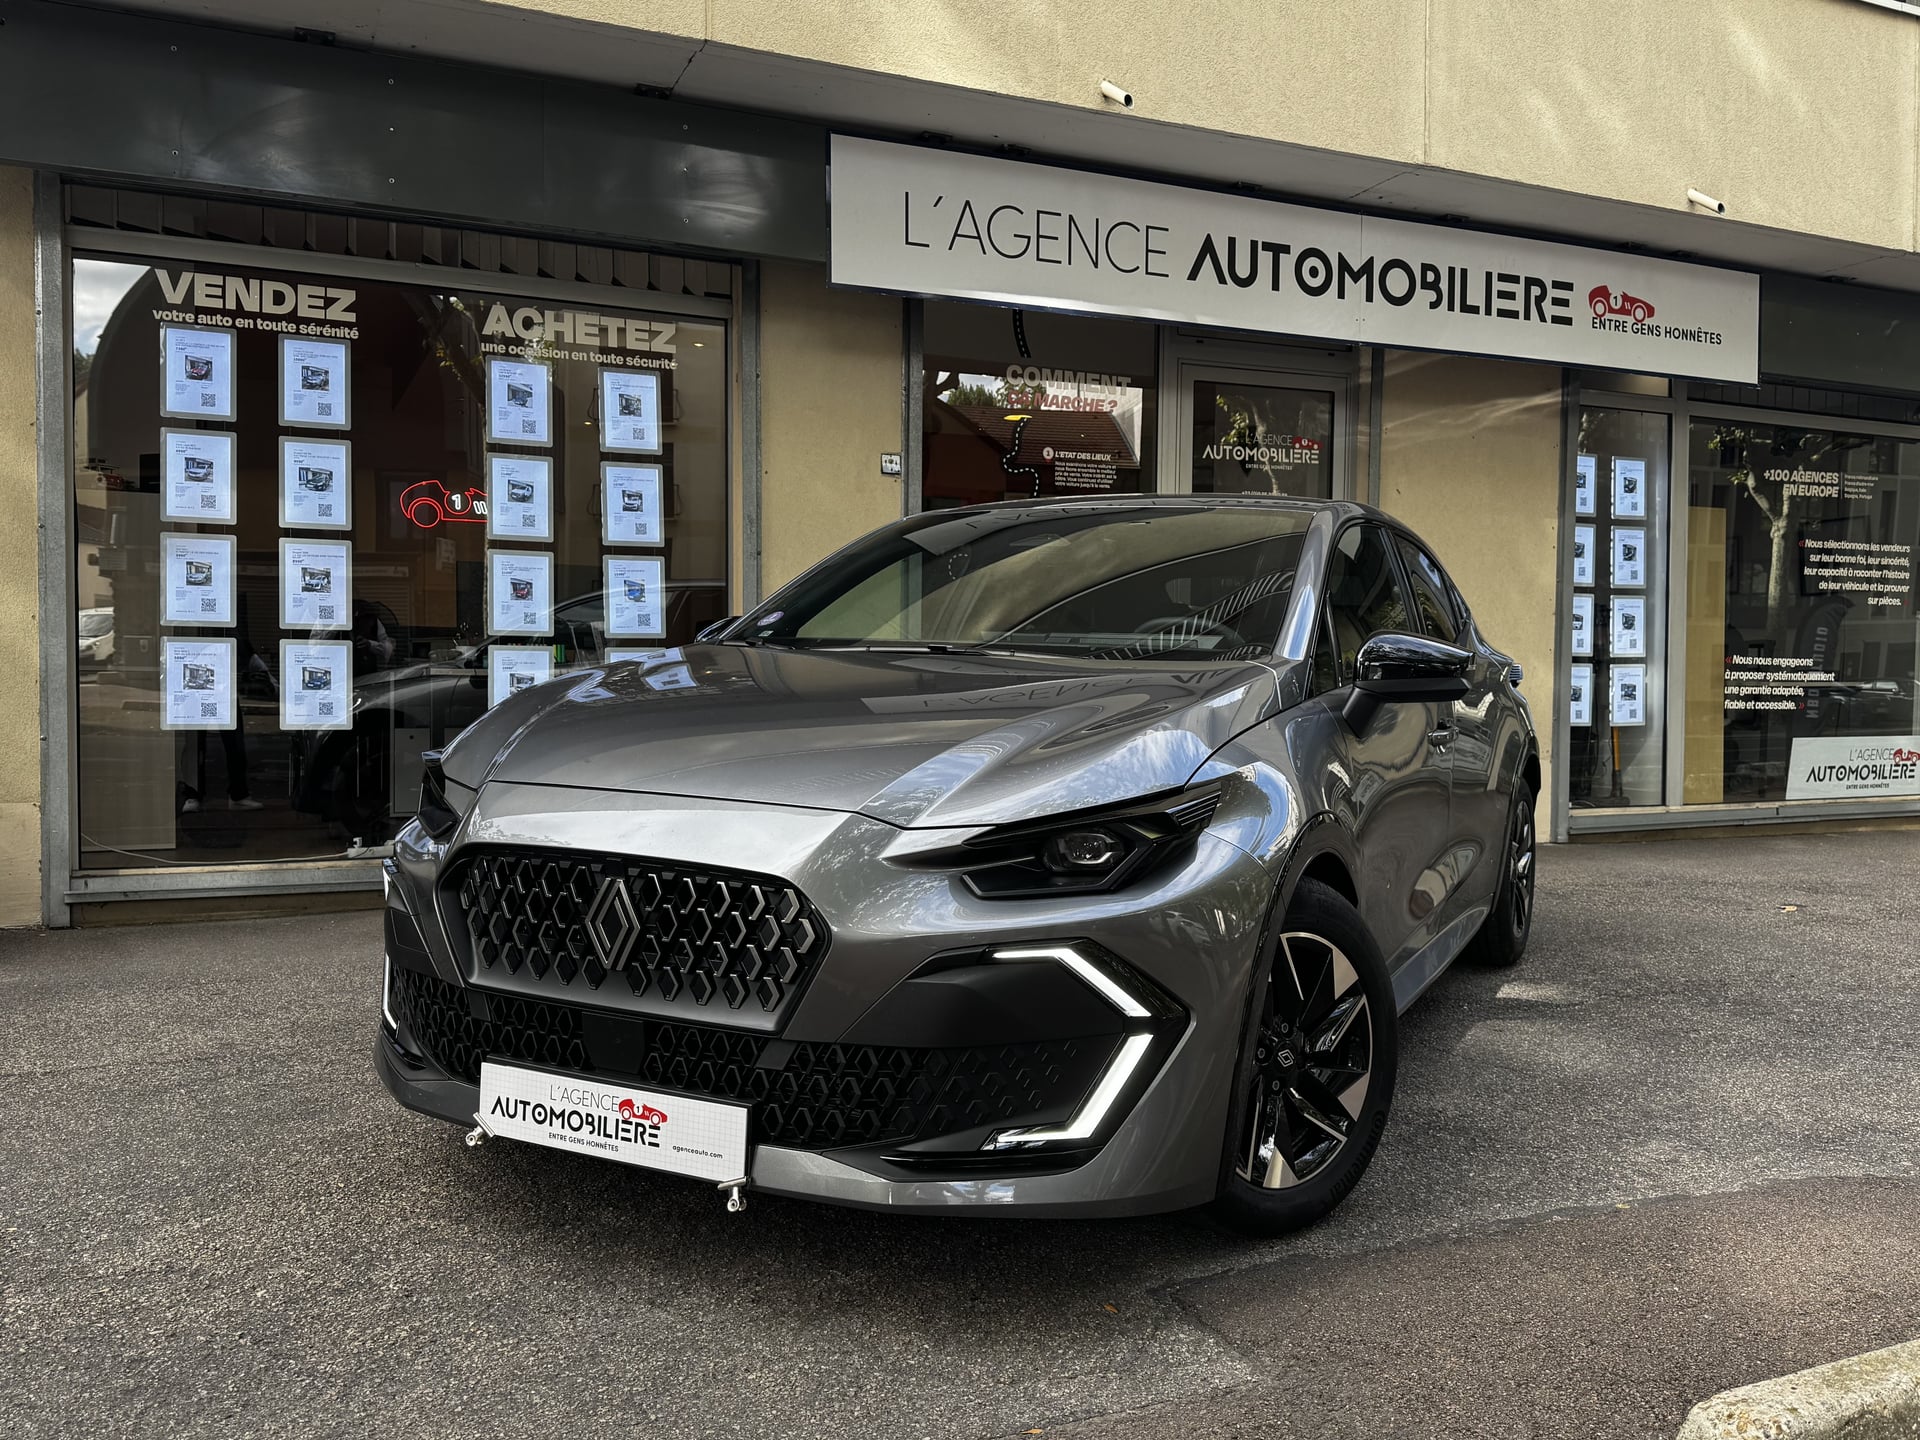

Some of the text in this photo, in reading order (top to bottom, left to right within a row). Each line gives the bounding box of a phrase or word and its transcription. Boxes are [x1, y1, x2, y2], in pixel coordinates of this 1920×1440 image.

[904, 190, 1574, 327] L'AGENCE AUTOMOBILIERE
[154, 268, 356, 322] VENDEZ
[152, 309, 359, 339] votre auto en toute sérénité
[481, 304, 676, 353] ACHETEZ
[1591, 316, 1722, 345] ENTRE GENS HONNÊTES
[480, 341, 679, 370] une occasion en toute sécurité
[1006, 364, 1131, 396] COMMENT
[1033, 392, 1105, 412] MARCHE
[1077, 452, 1090, 460] DES
[1091, 453, 1111, 461] LIEUX
[1202, 444, 1319, 464] AUTOMOBILIERE
[1763, 469, 1790, 481] +100
[1790, 470, 1840, 484] AGENCES
[1783, 483, 1798, 495] EN
[1798, 485, 1840, 497] EUROPE
[1732, 655, 1753, 665] Nous
[1753, 657, 1772, 665] nous
[1772, 657, 1814, 668] engageons
[1724, 669, 1835, 682] à proposer systématiquement
[1724, 685, 1805, 697] une garantie adaptée,
[1724, 699, 1746, 709] fiable
[1746, 699, 1755, 709] et
[1755, 699, 1797, 710] accessible.
[1806, 763, 1917, 783] AUTOMOBILIERE
[550, 1084, 620, 1113] L'AGENCE
[490, 1095, 661, 1148] AUTOMOBILIERE
[548, 1132, 619, 1152] ENTRE GENS HONNÊTES
[672, 1144, 723, 1159] agenceauto.com
